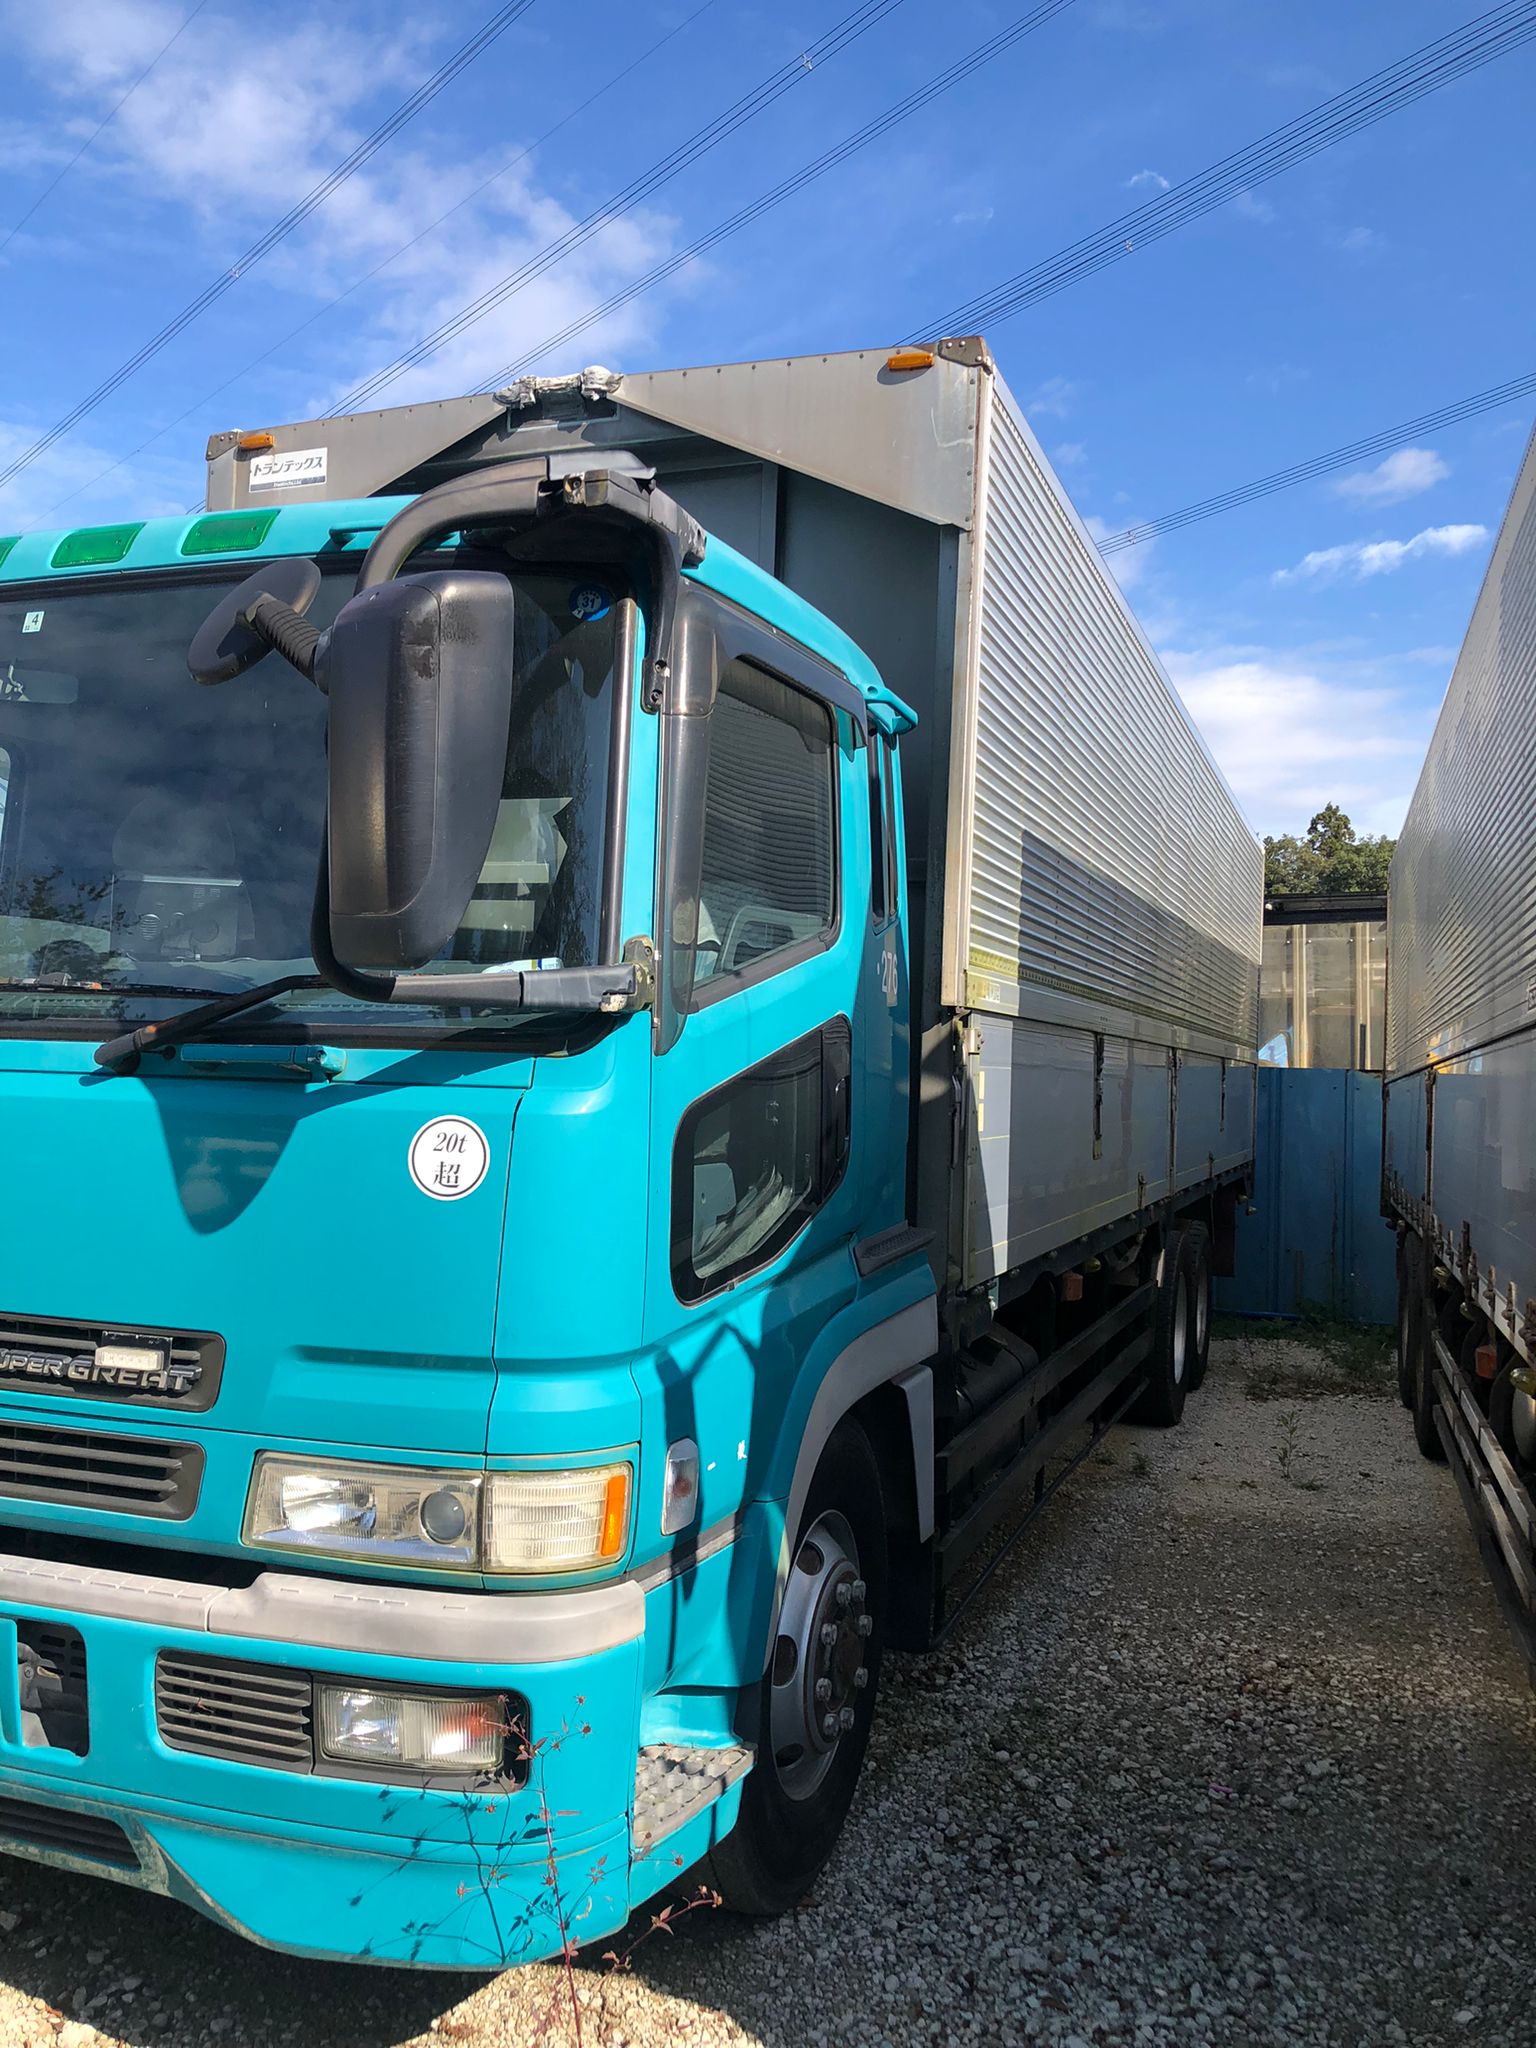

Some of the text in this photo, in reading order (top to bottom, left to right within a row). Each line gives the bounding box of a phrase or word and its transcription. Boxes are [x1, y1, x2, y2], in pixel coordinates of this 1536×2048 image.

[253, 456, 324, 477] トランテックス
[582, 596, 596, 609] 31
[32, 613, 40, 626] 4
[433, 1132, 467, 1154] 20t
[433, 1161, 461, 1188] 超
